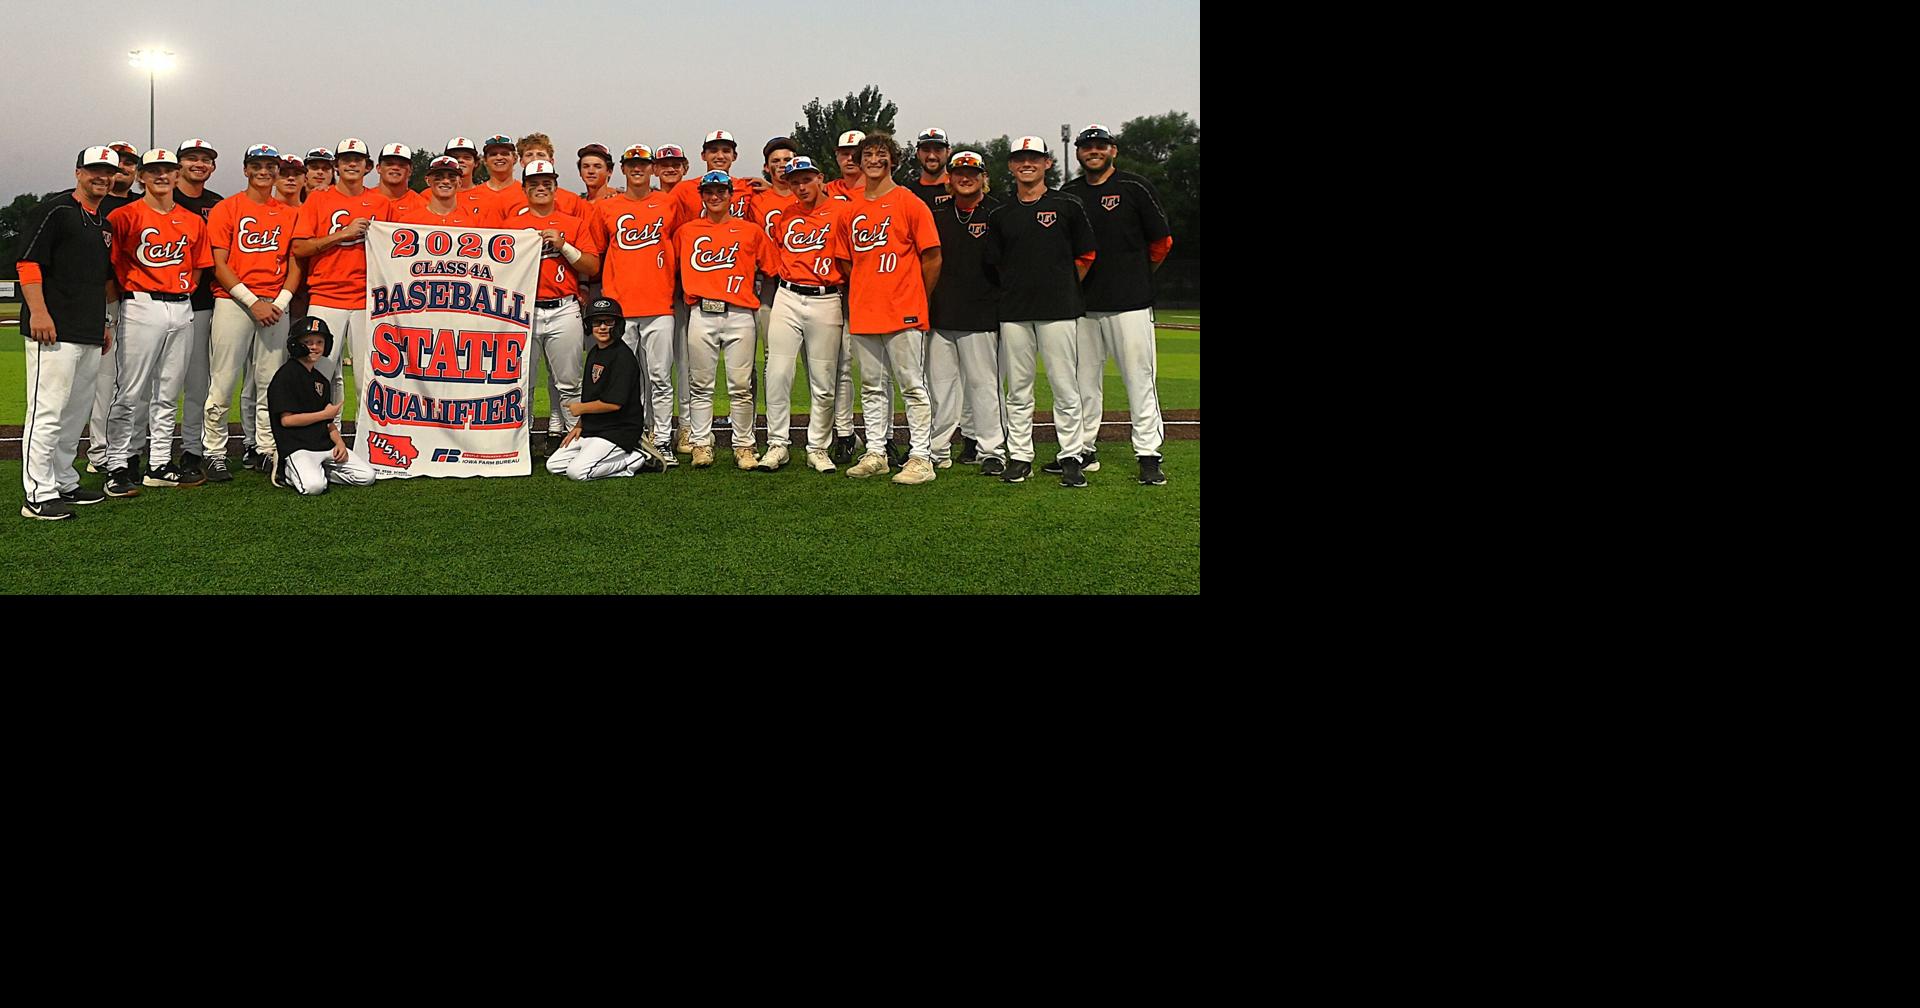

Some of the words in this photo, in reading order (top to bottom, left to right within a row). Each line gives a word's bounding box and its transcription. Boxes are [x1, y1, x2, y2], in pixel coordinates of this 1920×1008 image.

[195, 140, 203, 148] E
[457, 138, 465, 146] E
[716, 131, 724, 139] E
[847, 134, 856, 144] E
[1022, 138, 1031, 149] E
[100, 149, 110, 160] E
[348, 140, 357, 150] E
[394, 145, 402, 154] E
[157, 150, 166, 160] E
[536, 163, 544, 172] E
[238, 216, 280, 253] East
[616, 214, 663, 250] East
[783, 217, 830, 253] East
[852, 215, 891, 251] East
[136, 227, 189, 268] East
[391, 228, 516, 264] 2026
[690, 235, 739, 272] East
[657, 251, 665, 269] 6
[813, 256, 832, 276] 18
[878, 252, 897, 273] 10
[410, 260, 468, 277] CLASS
[469, 263, 493, 281] 4A
[555, 264, 565, 283] 8
[178, 271, 189, 290] 5
[726, 275, 744, 294] 17
[371, 280, 530, 329] BASEBALL
[311, 319, 320, 331] E
[371, 322, 528, 384] STATE
[366, 378, 525, 430] QUALIFIER
[371, 434, 408, 465] IHSAA
